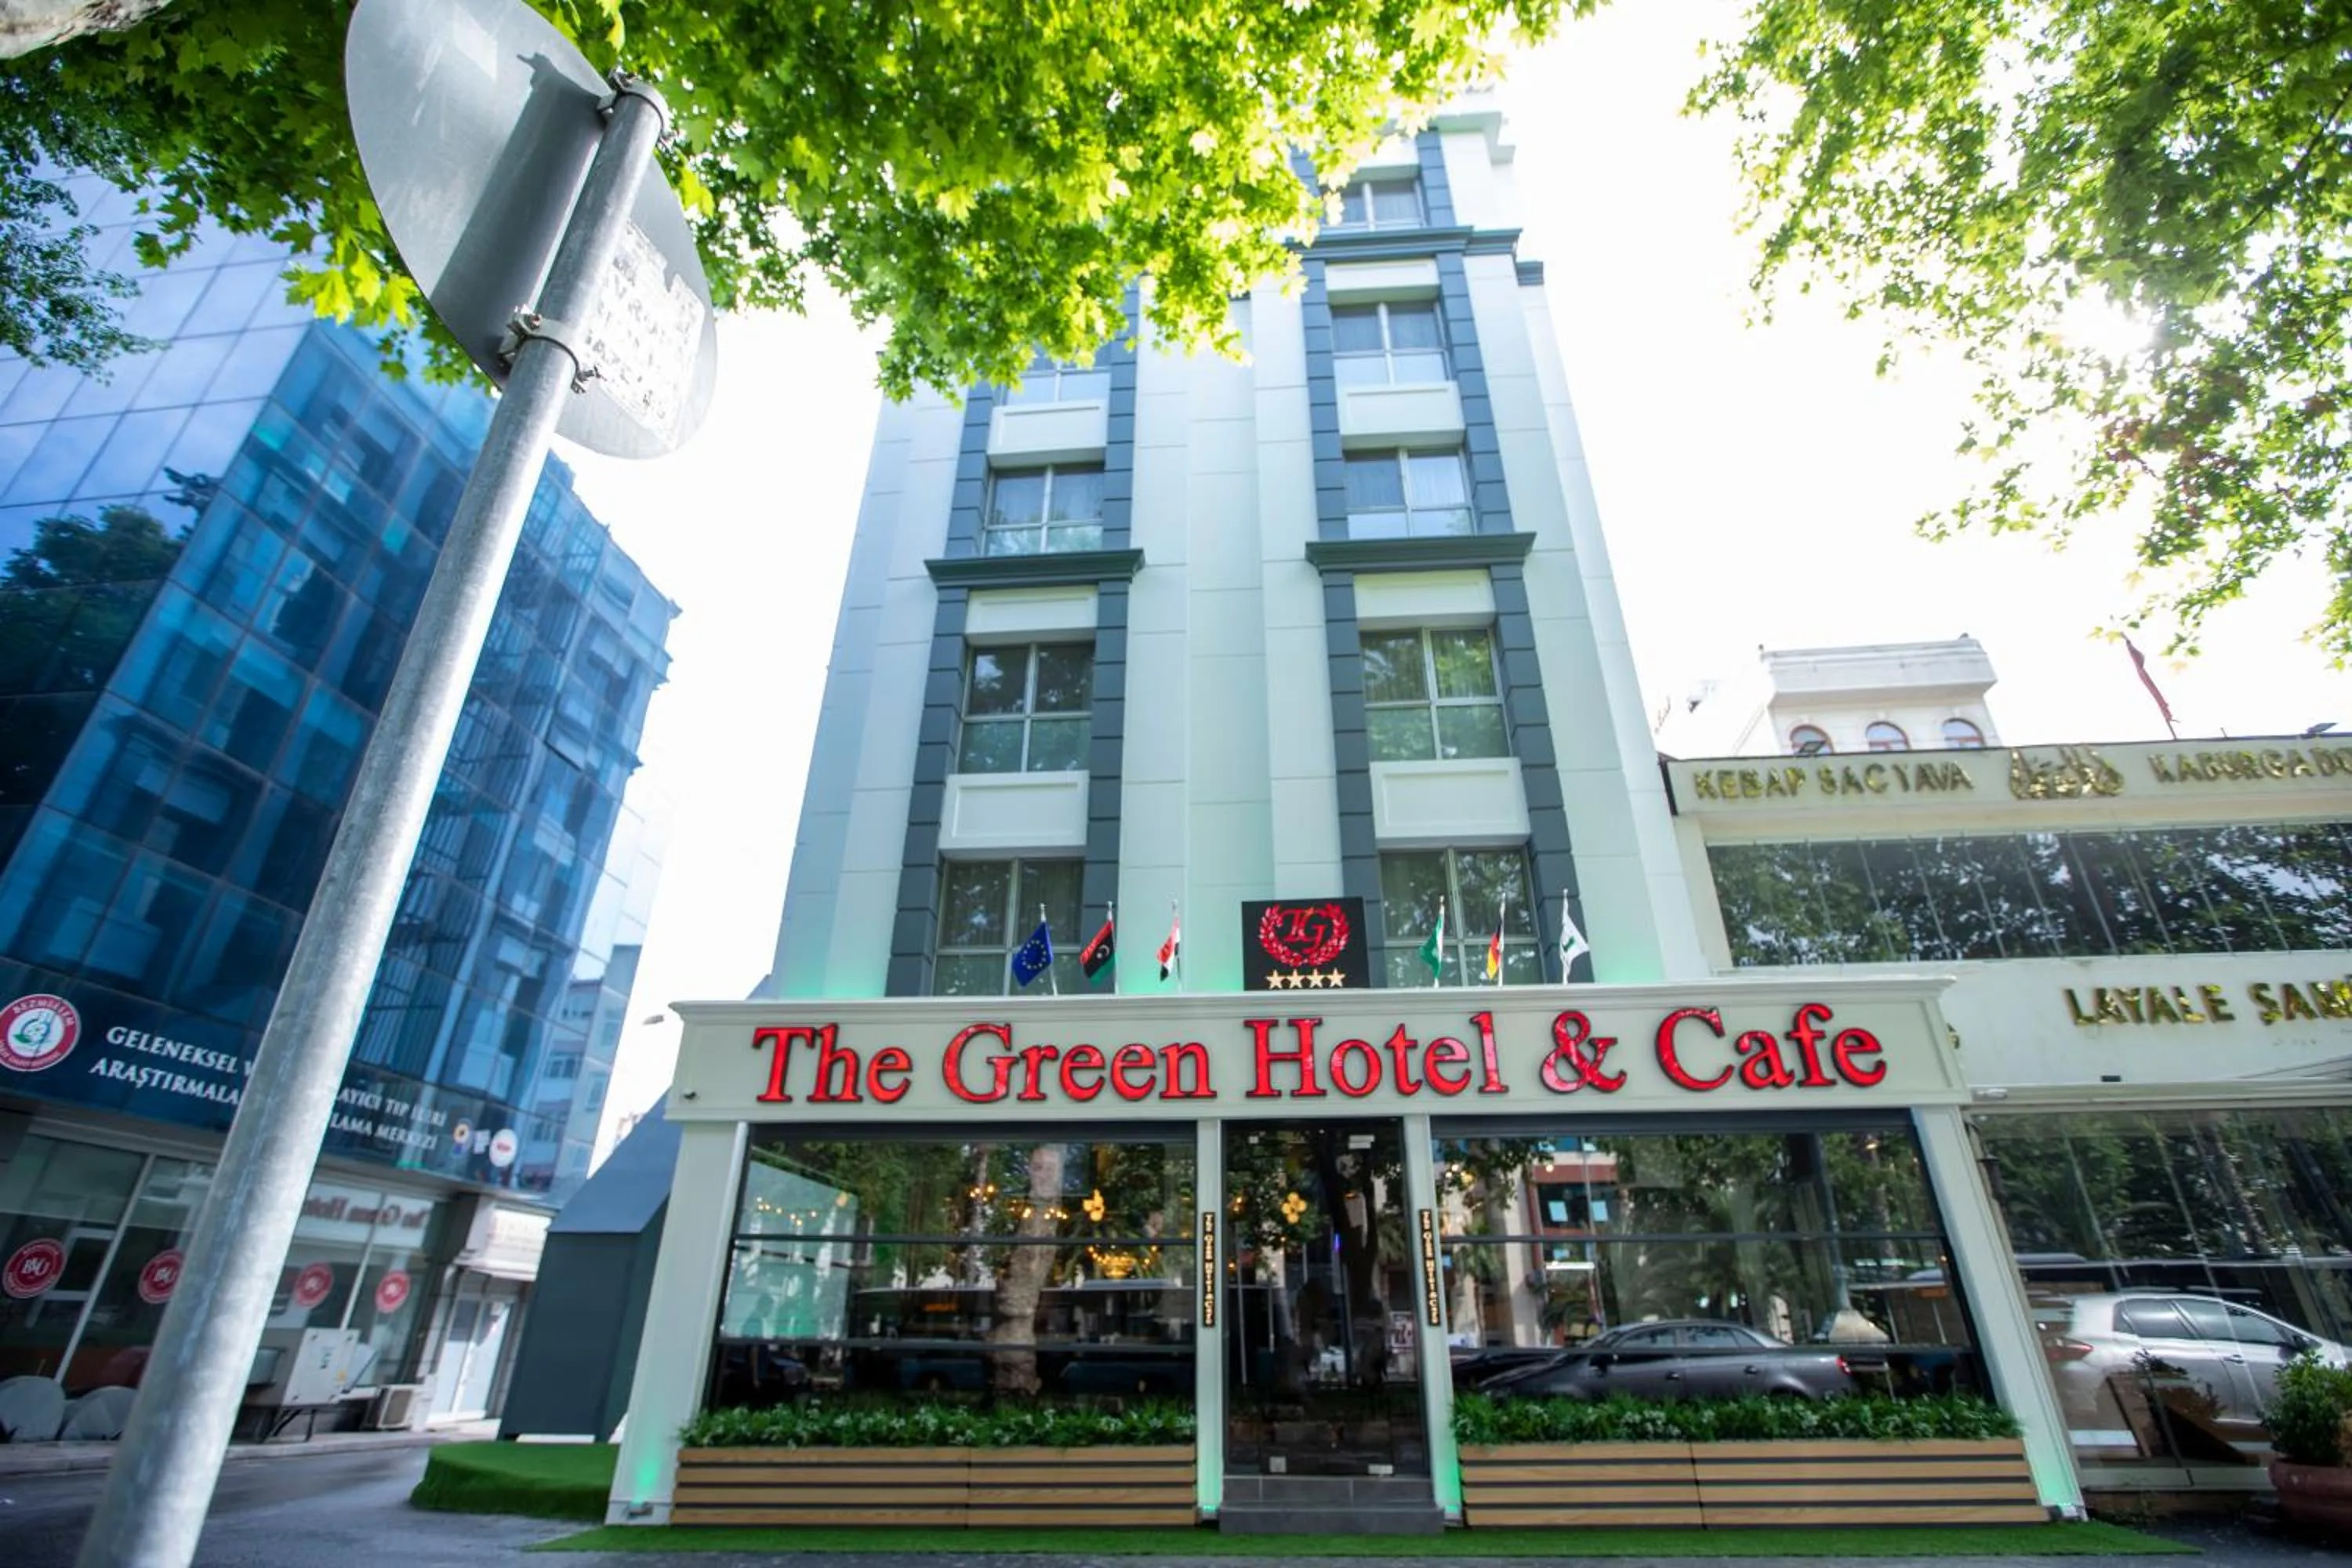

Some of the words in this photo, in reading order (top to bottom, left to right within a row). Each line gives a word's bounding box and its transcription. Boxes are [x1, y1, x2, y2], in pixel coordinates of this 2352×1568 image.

[2063, 985, 2236, 1025] LAYALE
[107, 1025, 238, 1074] GELENEKSEL
[753, 1022, 913, 1103] The
[943, 1022, 1218, 1104] Green
[1243, 1011, 1509, 1099] Hotel
[1538, 1010, 1628, 1093] &
[1655, 1003, 1887, 1091] Cafe
[89, 1058, 240, 1105] ARAŞTIRMALA
[329, 1112, 372, 1137] LAMA
